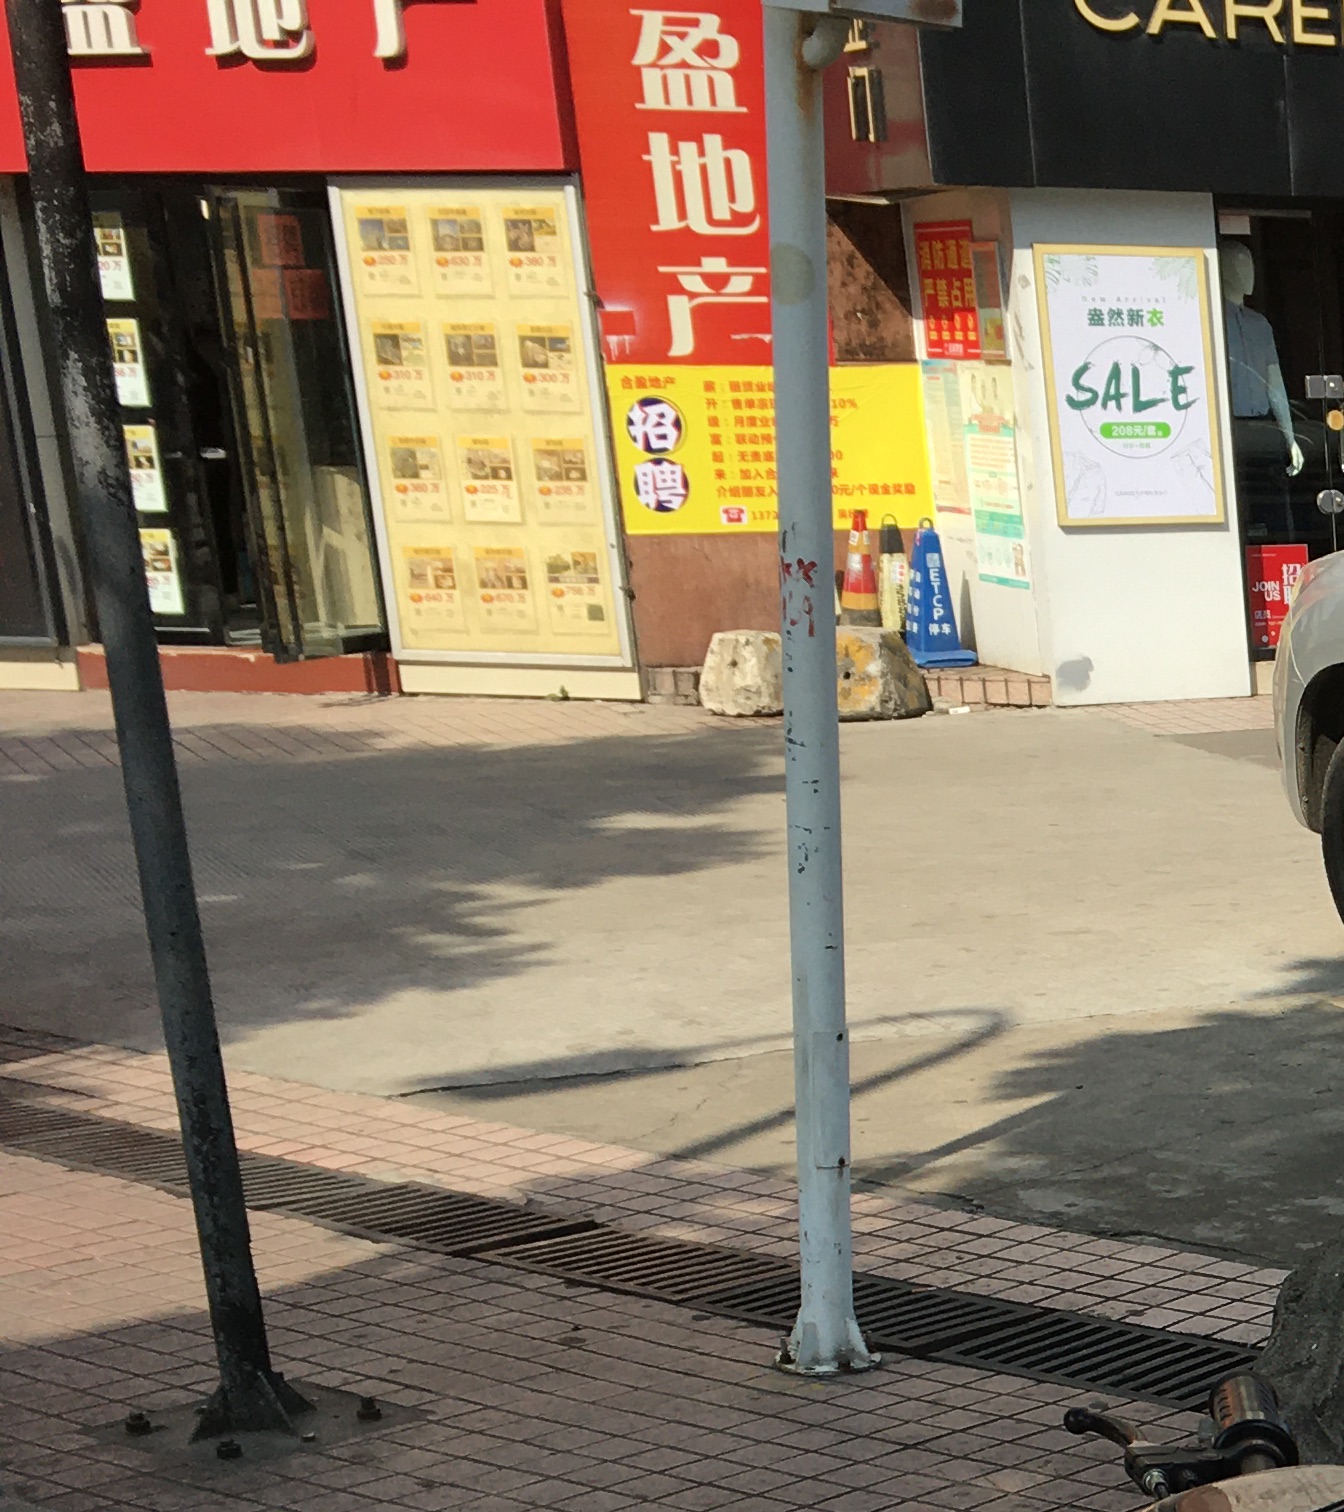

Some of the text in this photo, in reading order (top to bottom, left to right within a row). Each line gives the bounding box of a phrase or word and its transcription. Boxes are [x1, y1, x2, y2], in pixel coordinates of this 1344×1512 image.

[630, 8, 769, 358] 盈地产
[923, 277, 976, 308] 严禁占用
[1087, 307, 1165, 327] 盎然新衣
[1065, 361, 1200, 414] SALE
[929, 568, 944, 621] ETCP
[1252, 580, 1280, 592] JOIN
[1264, 591, 1281, 602] US
[928, 622, 952, 636] 停车
